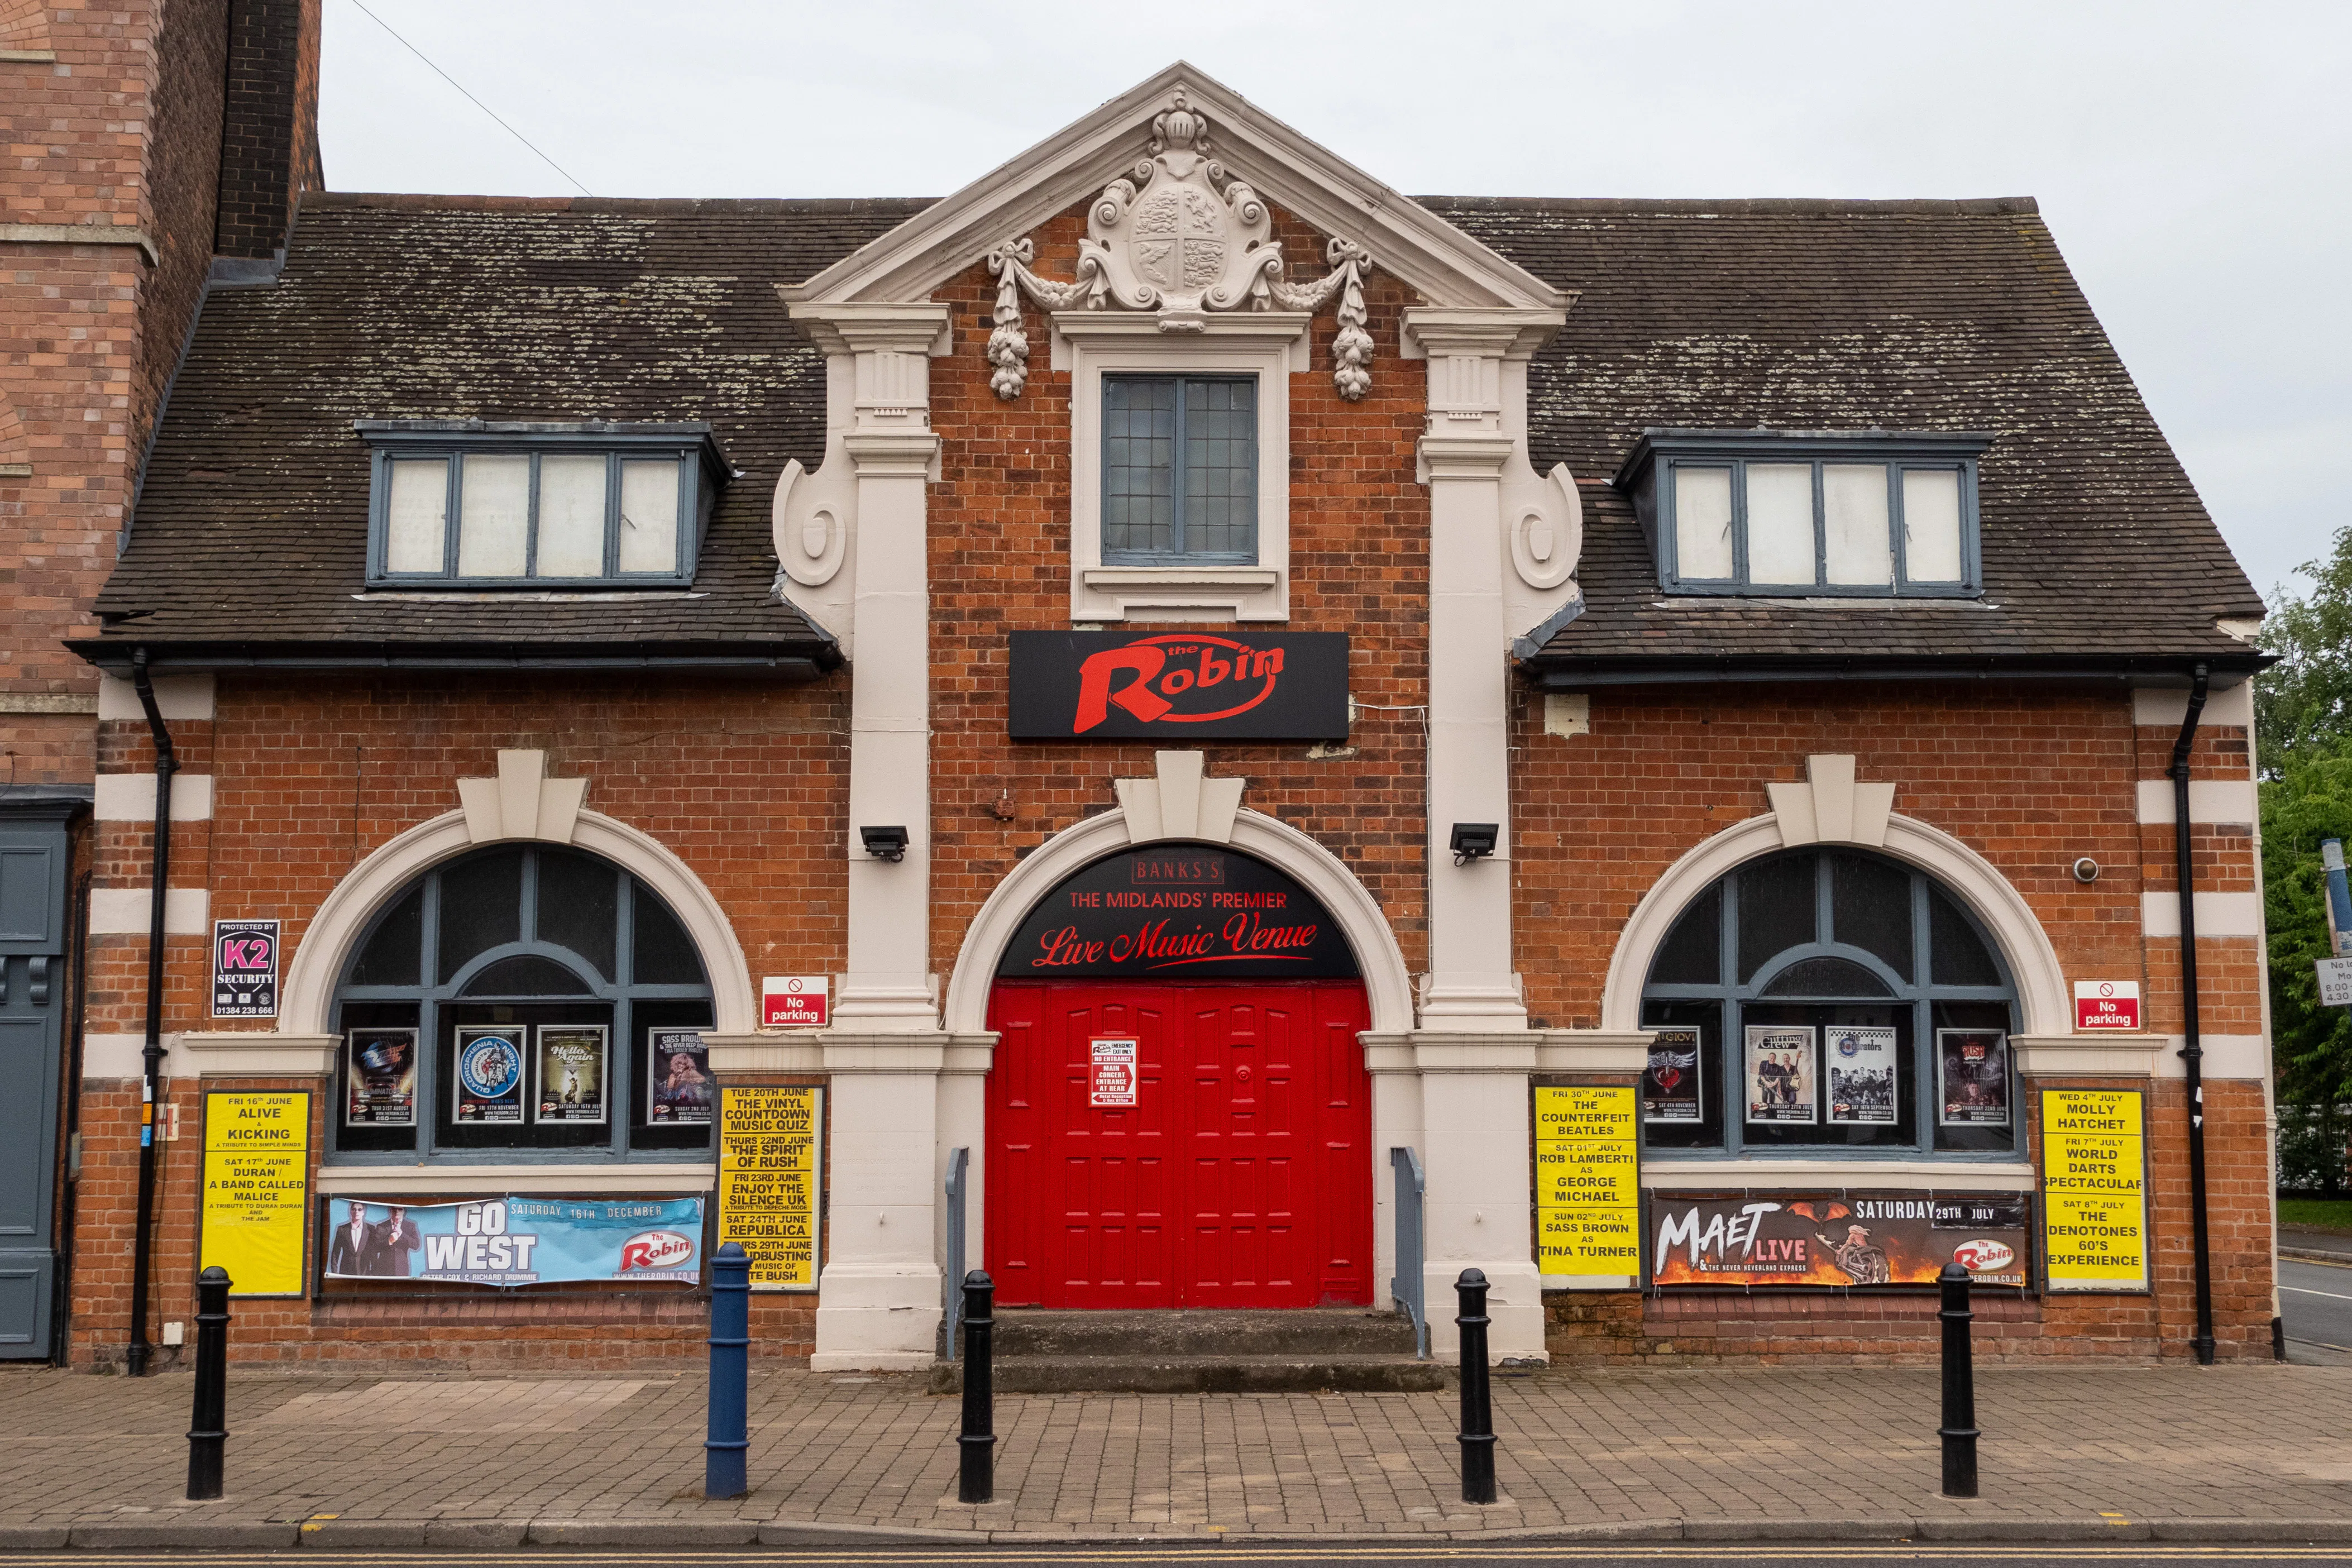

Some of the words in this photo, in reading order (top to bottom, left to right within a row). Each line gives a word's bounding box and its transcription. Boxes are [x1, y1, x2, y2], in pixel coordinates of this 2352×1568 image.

[1168, 645, 1199, 656] the
[1073, 645, 1284, 734] Robin
[1137, 861, 1220, 879] BANKS'S
[1070, 892, 1100, 908] THE
[1107, 892, 1206, 908] MIDLANDS'
[1213, 893, 1287, 909] PREMIER
[1031, 926, 1104, 967] Live
[1109, 919, 1213, 963] Music
[1222, 912, 1317, 951] Venue
[224, 939, 269, 968] K2
[217, 974, 274, 983] SECURITY
[2327, 992, 2349, 1001] 4.30
[787, 997, 804, 1007] No
[2100, 1002, 2116, 1011] No
[772, 1010, 818, 1022] parking
[2086, 1014, 2130, 1026] parking
[662, 1035, 679, 1044] SASS
[556, 1051, 596, 1063] Again
[1962, 1046, 1985, 1059] RUSH
[464, 1040, 494, 1093] QUADROPHENIA
[502, 1045, 517, 1072] NIGHT
[735, 1099, 761, 1108] THE
[766, 1099, 804, 1108] VINYL
[238, 1108, 281, 1118] ALIVE
[725, 1110, 810, 1120] COUNTDOWN
[2067, 1105, 2115, 1115] MOLLY
[1542, 1113, 1629, 1122] COUNTERFEIT
[731, 1121, 772, 1130] MUSIC
[776, 1121, 808, 1131] QUIZ
[2058, 1119, 2125, 1129] HATCHET
[228, 1129, 290, 1139] KICKING
[730, 1146, 757, 1155] THE
[762, 1145, 805, 1155] SPIRIT
[2067, 1149, 2117, 1159] WORLD
[738, 1158, 755, 1167] OF
[760, 1157, 797, 1167] RUSH
[1570, 1155, 1633, 1163] LAMBERTI
[2069, 1163, 2116, 1174] DARTS
[209, 1180, 217, 1189] A
[222, 1180, 254, 1189] BAND
[259, 1180, 303, 1189] CALLED
[1557, 1177, 1616, 1187] GEORGE
[733, 1184, 773, 1194] ENJOY
[778, 1184, 804, 1193] THE
[729, 1196, 783, 1204] SILENCE
[788, 1195, 806, 1204] UK
[1555, 1192, 1619, 1201] MICHAEL
[511, 1204, 561, 1216] SATURDAY
[571, 1209, 595, 1219] 16TH
[608, 1206, 662, 1217] DECEMBER
[1856, 1201, 1934, 1218] SATURDAY
[1936, 1208, 1961, 1218] 29TH
[1972, 1209, 1994, 1219] JULY
[457, 1202, 506, 1235] GO
[2078, 1212, 2107, 1221] THE
[729, 1225, 805, 1235] REPUBLICA
[1546, 1224, 1578, 1232] SASS
[1583, 1224, 1629, 1233] BROWN
[2049, 1226, 2137, 1236] DENOTONES
[1656, 1203, 1781, 1275] MAET
[1540, 1246, 1572, 1256] TINA
[1578, 1246, 1637, 1256] TURNER
[1756, 1240, 1805, 1260] LIVE
[2079, 1241, 2108, 1251] 60'S
[427, 1236, 536, 1270] WEST
[621, 1240, 691, 1271] Robin
[1954, 1249, 2011, 1270] Robin
[2049, 1255, 2139, 1265] EXPERIENCE
[1700, 1260, 1707, 1270] &
